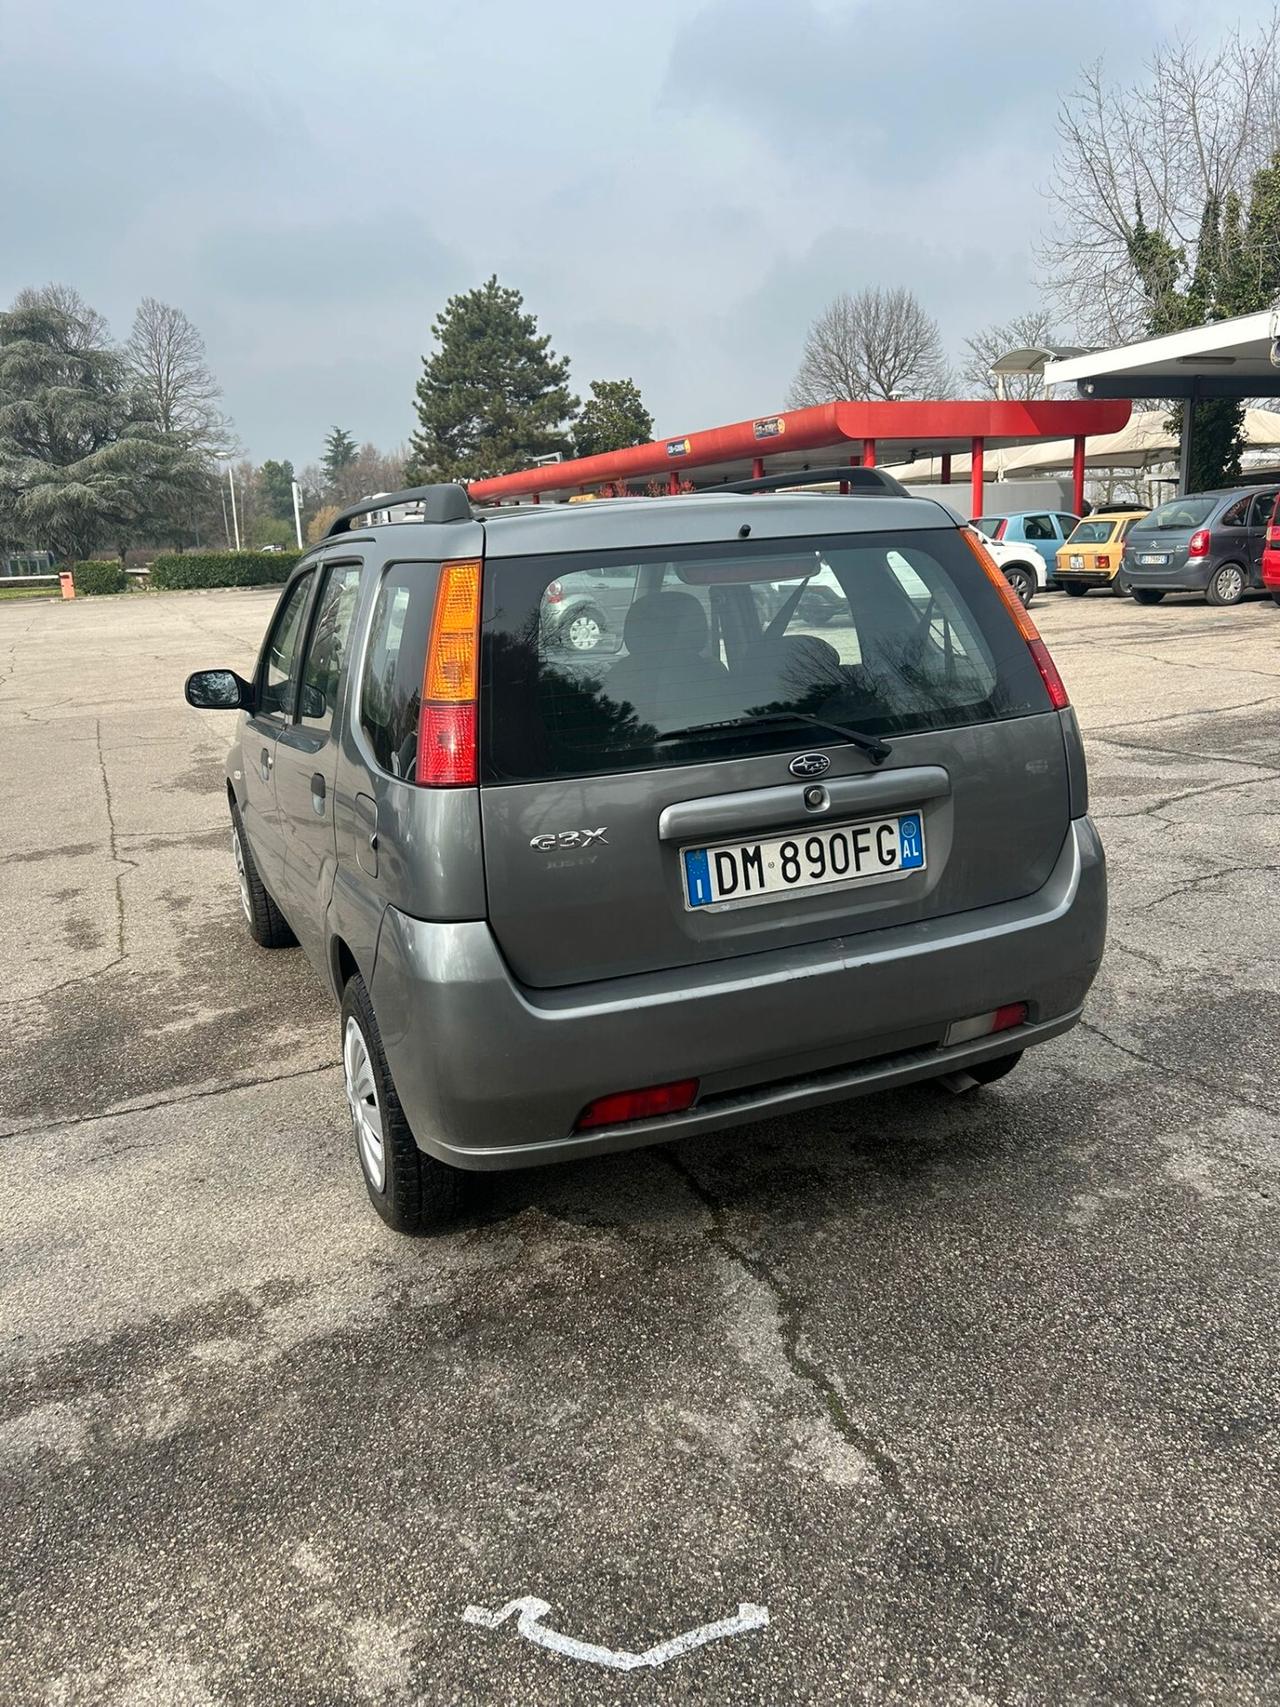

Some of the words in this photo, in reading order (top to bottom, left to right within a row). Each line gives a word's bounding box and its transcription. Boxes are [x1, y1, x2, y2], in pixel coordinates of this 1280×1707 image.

[530, 826, 609, 851] G3X
[714, 846, 765, 896] DM
[779, 824, 897, 884] 890FG
[903, 840, 919, 859] AL
